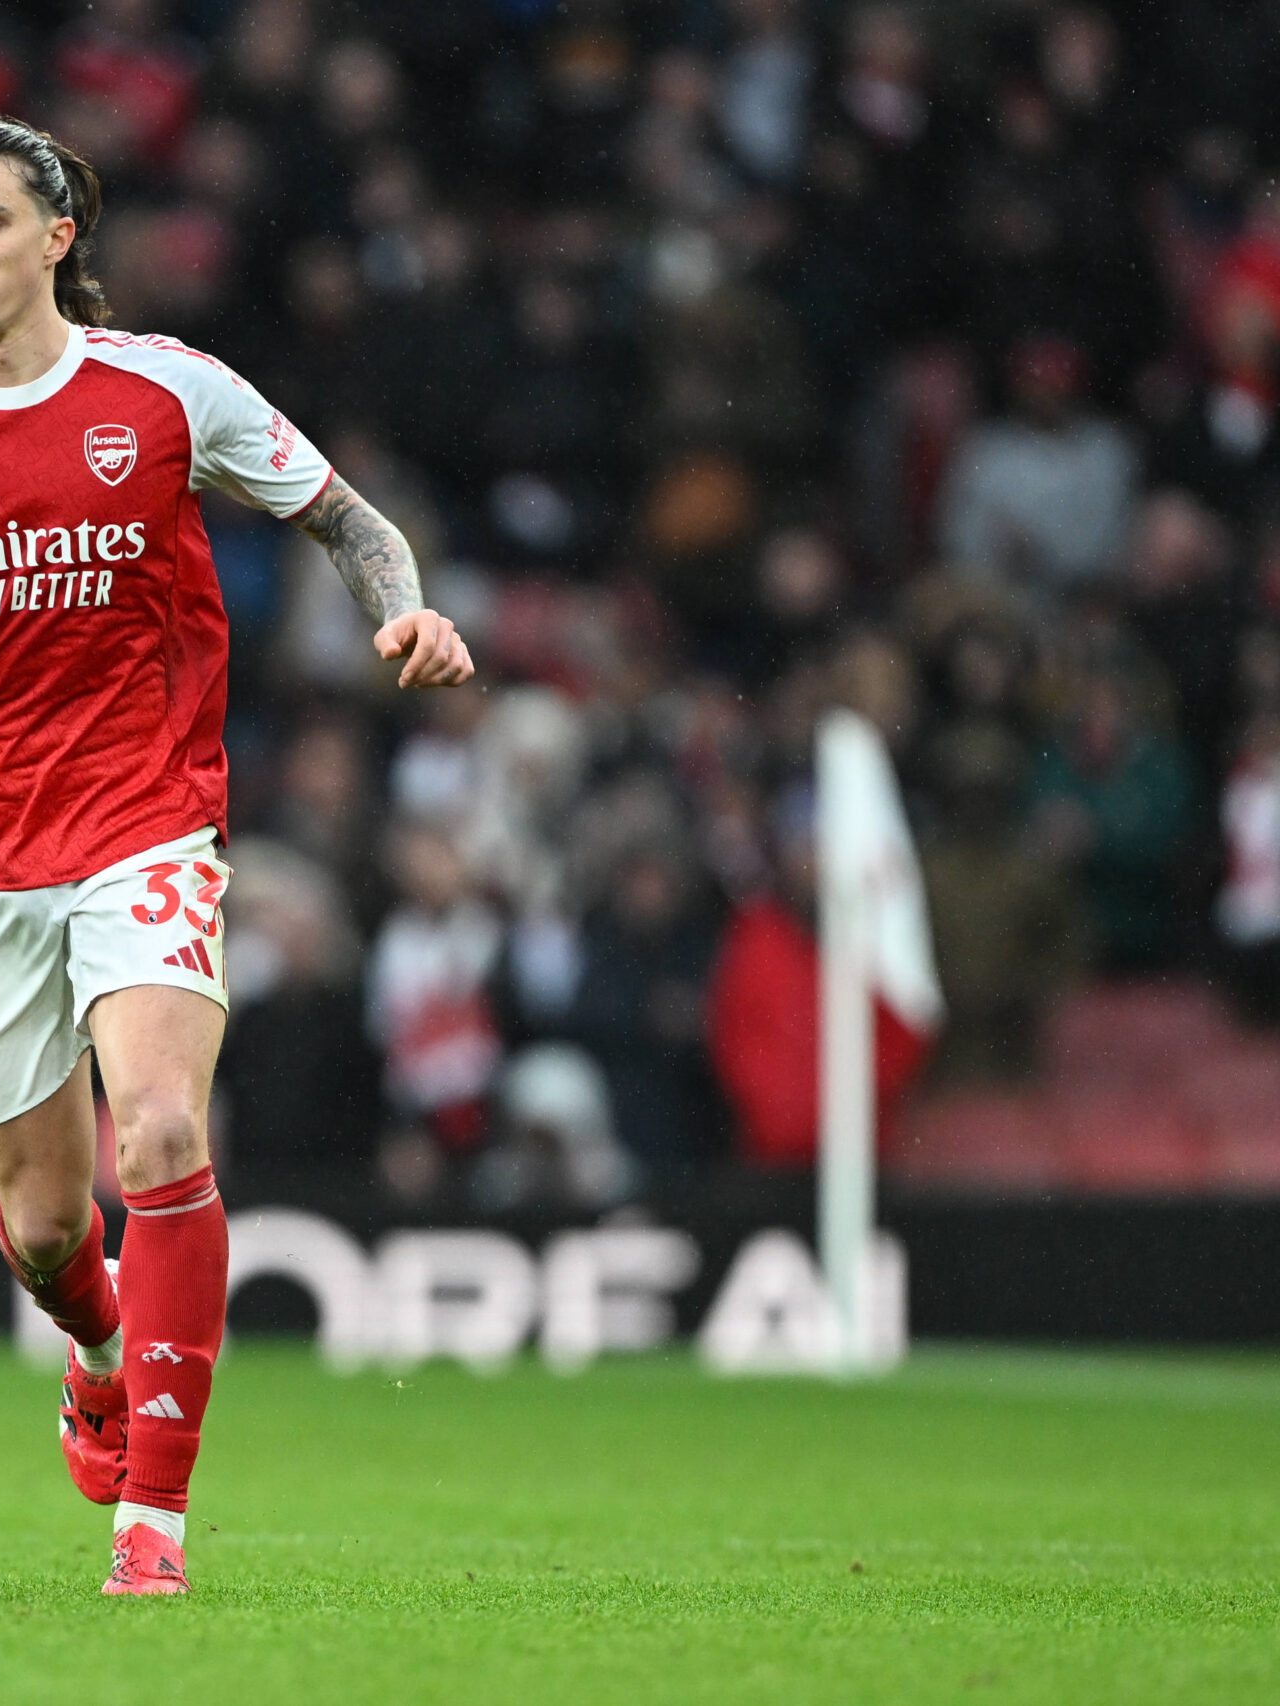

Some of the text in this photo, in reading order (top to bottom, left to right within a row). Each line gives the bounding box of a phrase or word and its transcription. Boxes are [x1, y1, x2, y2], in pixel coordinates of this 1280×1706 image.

[92, 434, 130, 446] Arsenal
[10, 570, 113, 612] BETTER
[130, 861, 224, 937] 33
